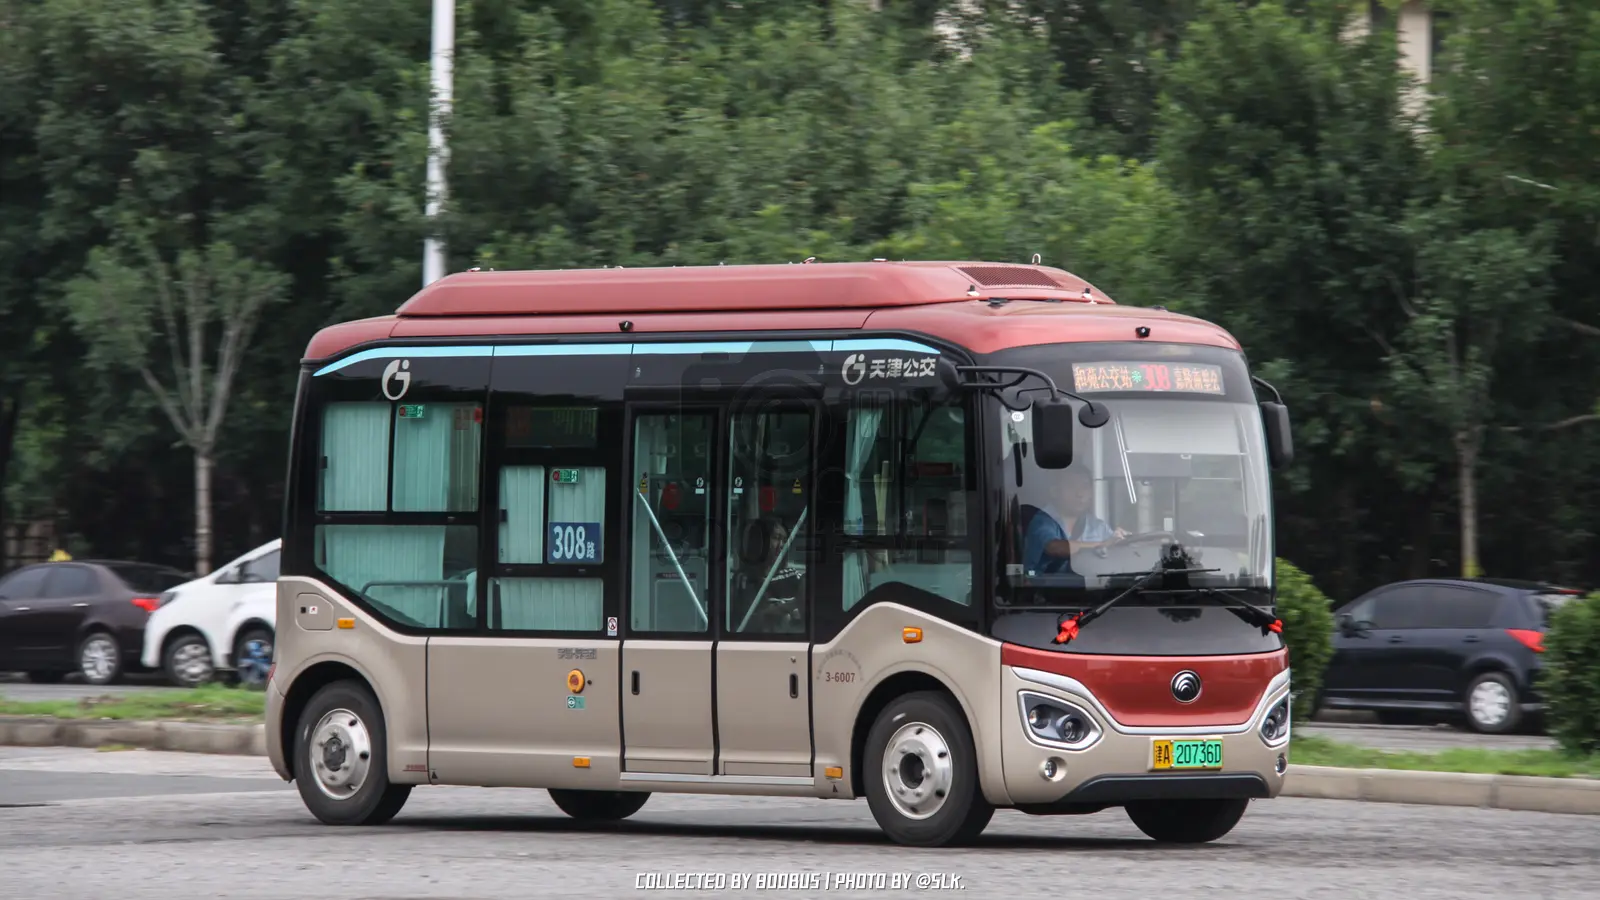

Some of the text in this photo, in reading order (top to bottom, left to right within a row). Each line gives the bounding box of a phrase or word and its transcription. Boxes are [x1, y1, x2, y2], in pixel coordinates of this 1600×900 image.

[869, 357, 937, 379] 天津公交
[1140, 364, 1172, 391] 308
[825, 671, 856, 683] 3-6007
